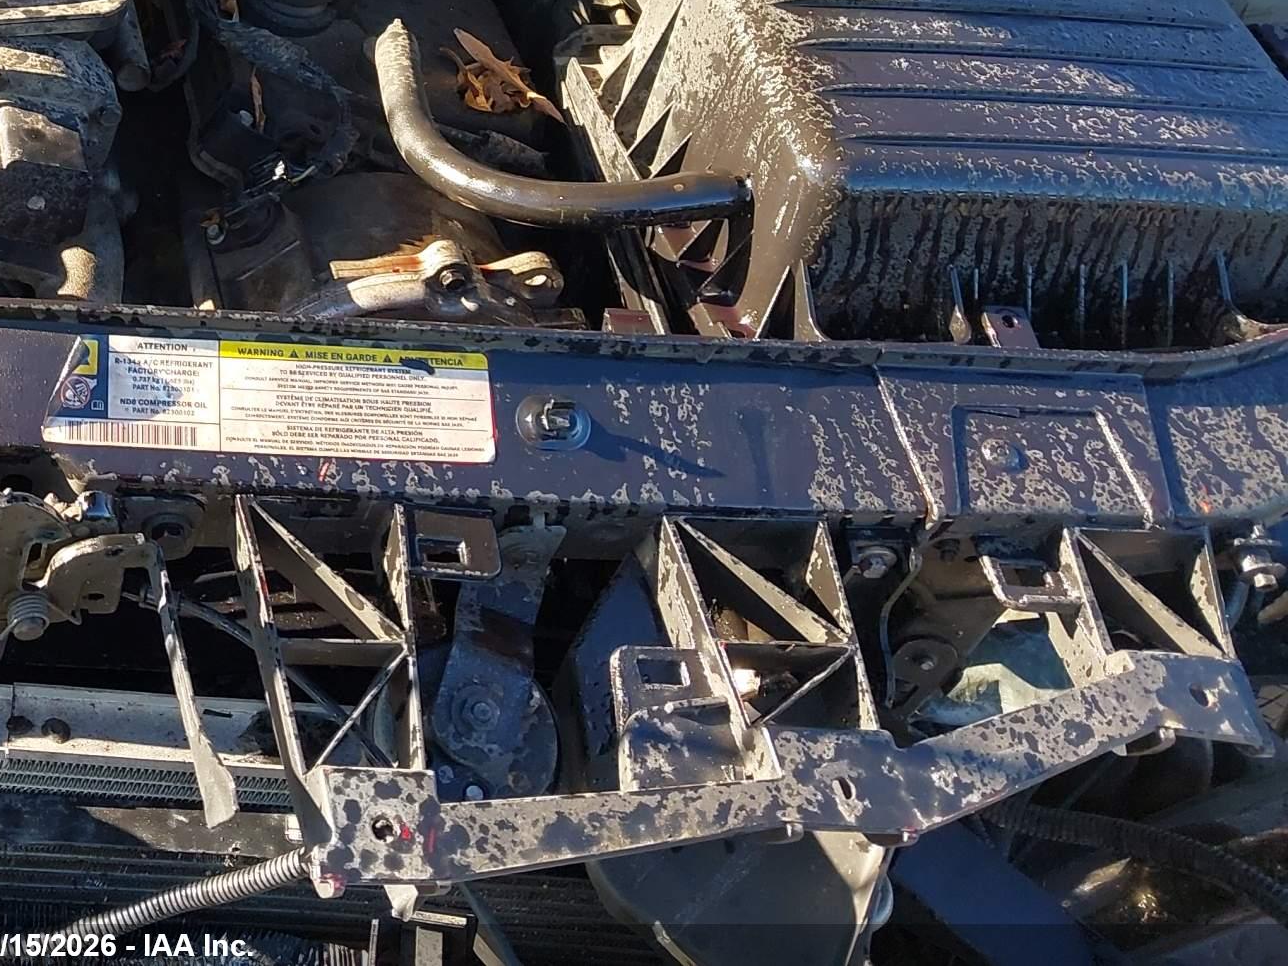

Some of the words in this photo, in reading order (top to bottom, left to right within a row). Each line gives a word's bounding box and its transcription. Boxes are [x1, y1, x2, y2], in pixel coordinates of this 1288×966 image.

[137, 342, 188, 351] ATTENTION
[237, 348, 284, 357] WARNING
[305, 351, 329, 360] MISE
[331, 353, 344, 361] EN
[346, 353, 377, 362] GARDE
